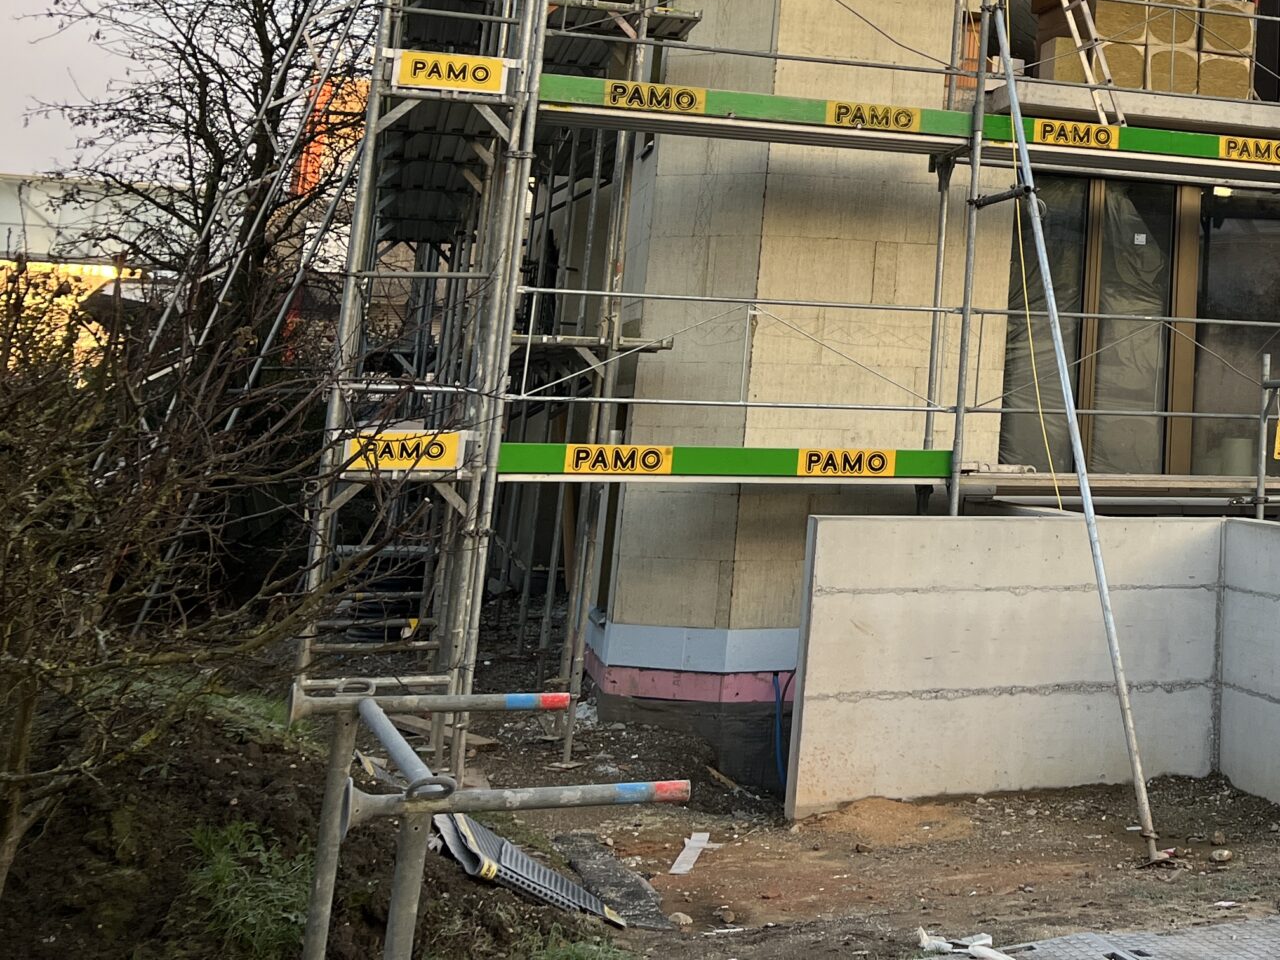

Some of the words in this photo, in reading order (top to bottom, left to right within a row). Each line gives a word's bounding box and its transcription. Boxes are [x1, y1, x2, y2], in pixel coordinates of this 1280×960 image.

[411, 60, 490, 83] PAMO
[609, 83, 697, 111] PAMO
[835, 104, 914, 129] PAMO
[1040, 123, 1112, 147] PAMO
[362, 441, 445, 461] PAMO
[572, 449, 662, 471] PAMO
[806, 453, 889, 473] PAMO
